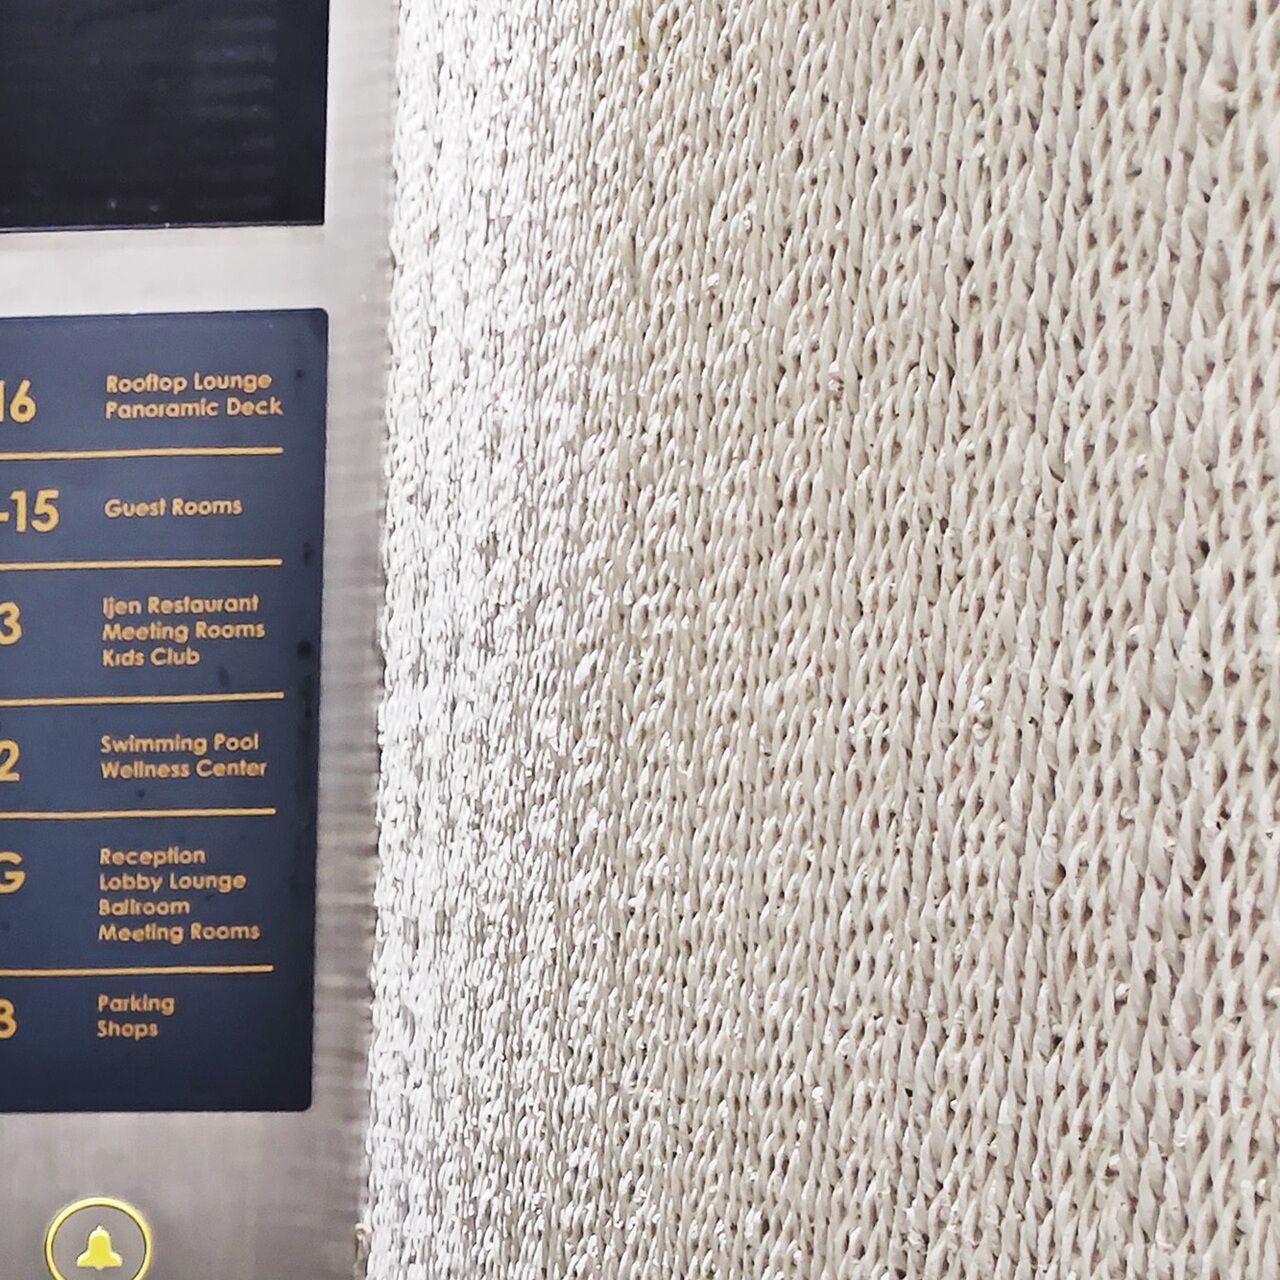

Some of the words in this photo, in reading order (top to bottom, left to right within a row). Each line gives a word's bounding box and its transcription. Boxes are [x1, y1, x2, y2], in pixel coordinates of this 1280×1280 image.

[106, 374, 187, 394] Rooftop
[194, 372, 271, 394] Lounge
[106, 400, 219, 419] Panoramic
[226, 397, 283, 416] Deck
[105, 500, 166, 517] Guest
[172, 498, 242, 516] Rooms
[148, 596, 259, 614] Restaurant
[103, 622, 188, 643] Meeting
[195, 621, 265, 638] Rooms
[103, 650, 145, 666] Kids
[150, 646, 200, 667] Club
[102, 736, 208, 756] Swimming
[213, 733, 259, 751] Pool
[102, 762, 189, 778] Wellness
[195, 759, 266, 776] Center
[100, 848, 205, 868] Reception
[99, 874, 163, 893] Lobby
[169, 873, 246, 893] Lounge
[100, 899, 189, 916] Ballroom
[99, 924, 184, 944] Meeting
[190, 923, 260, 940] Rooms
[98, 996, 176, 1016] Parking
[98, 1020, 158, 1040] Shops
